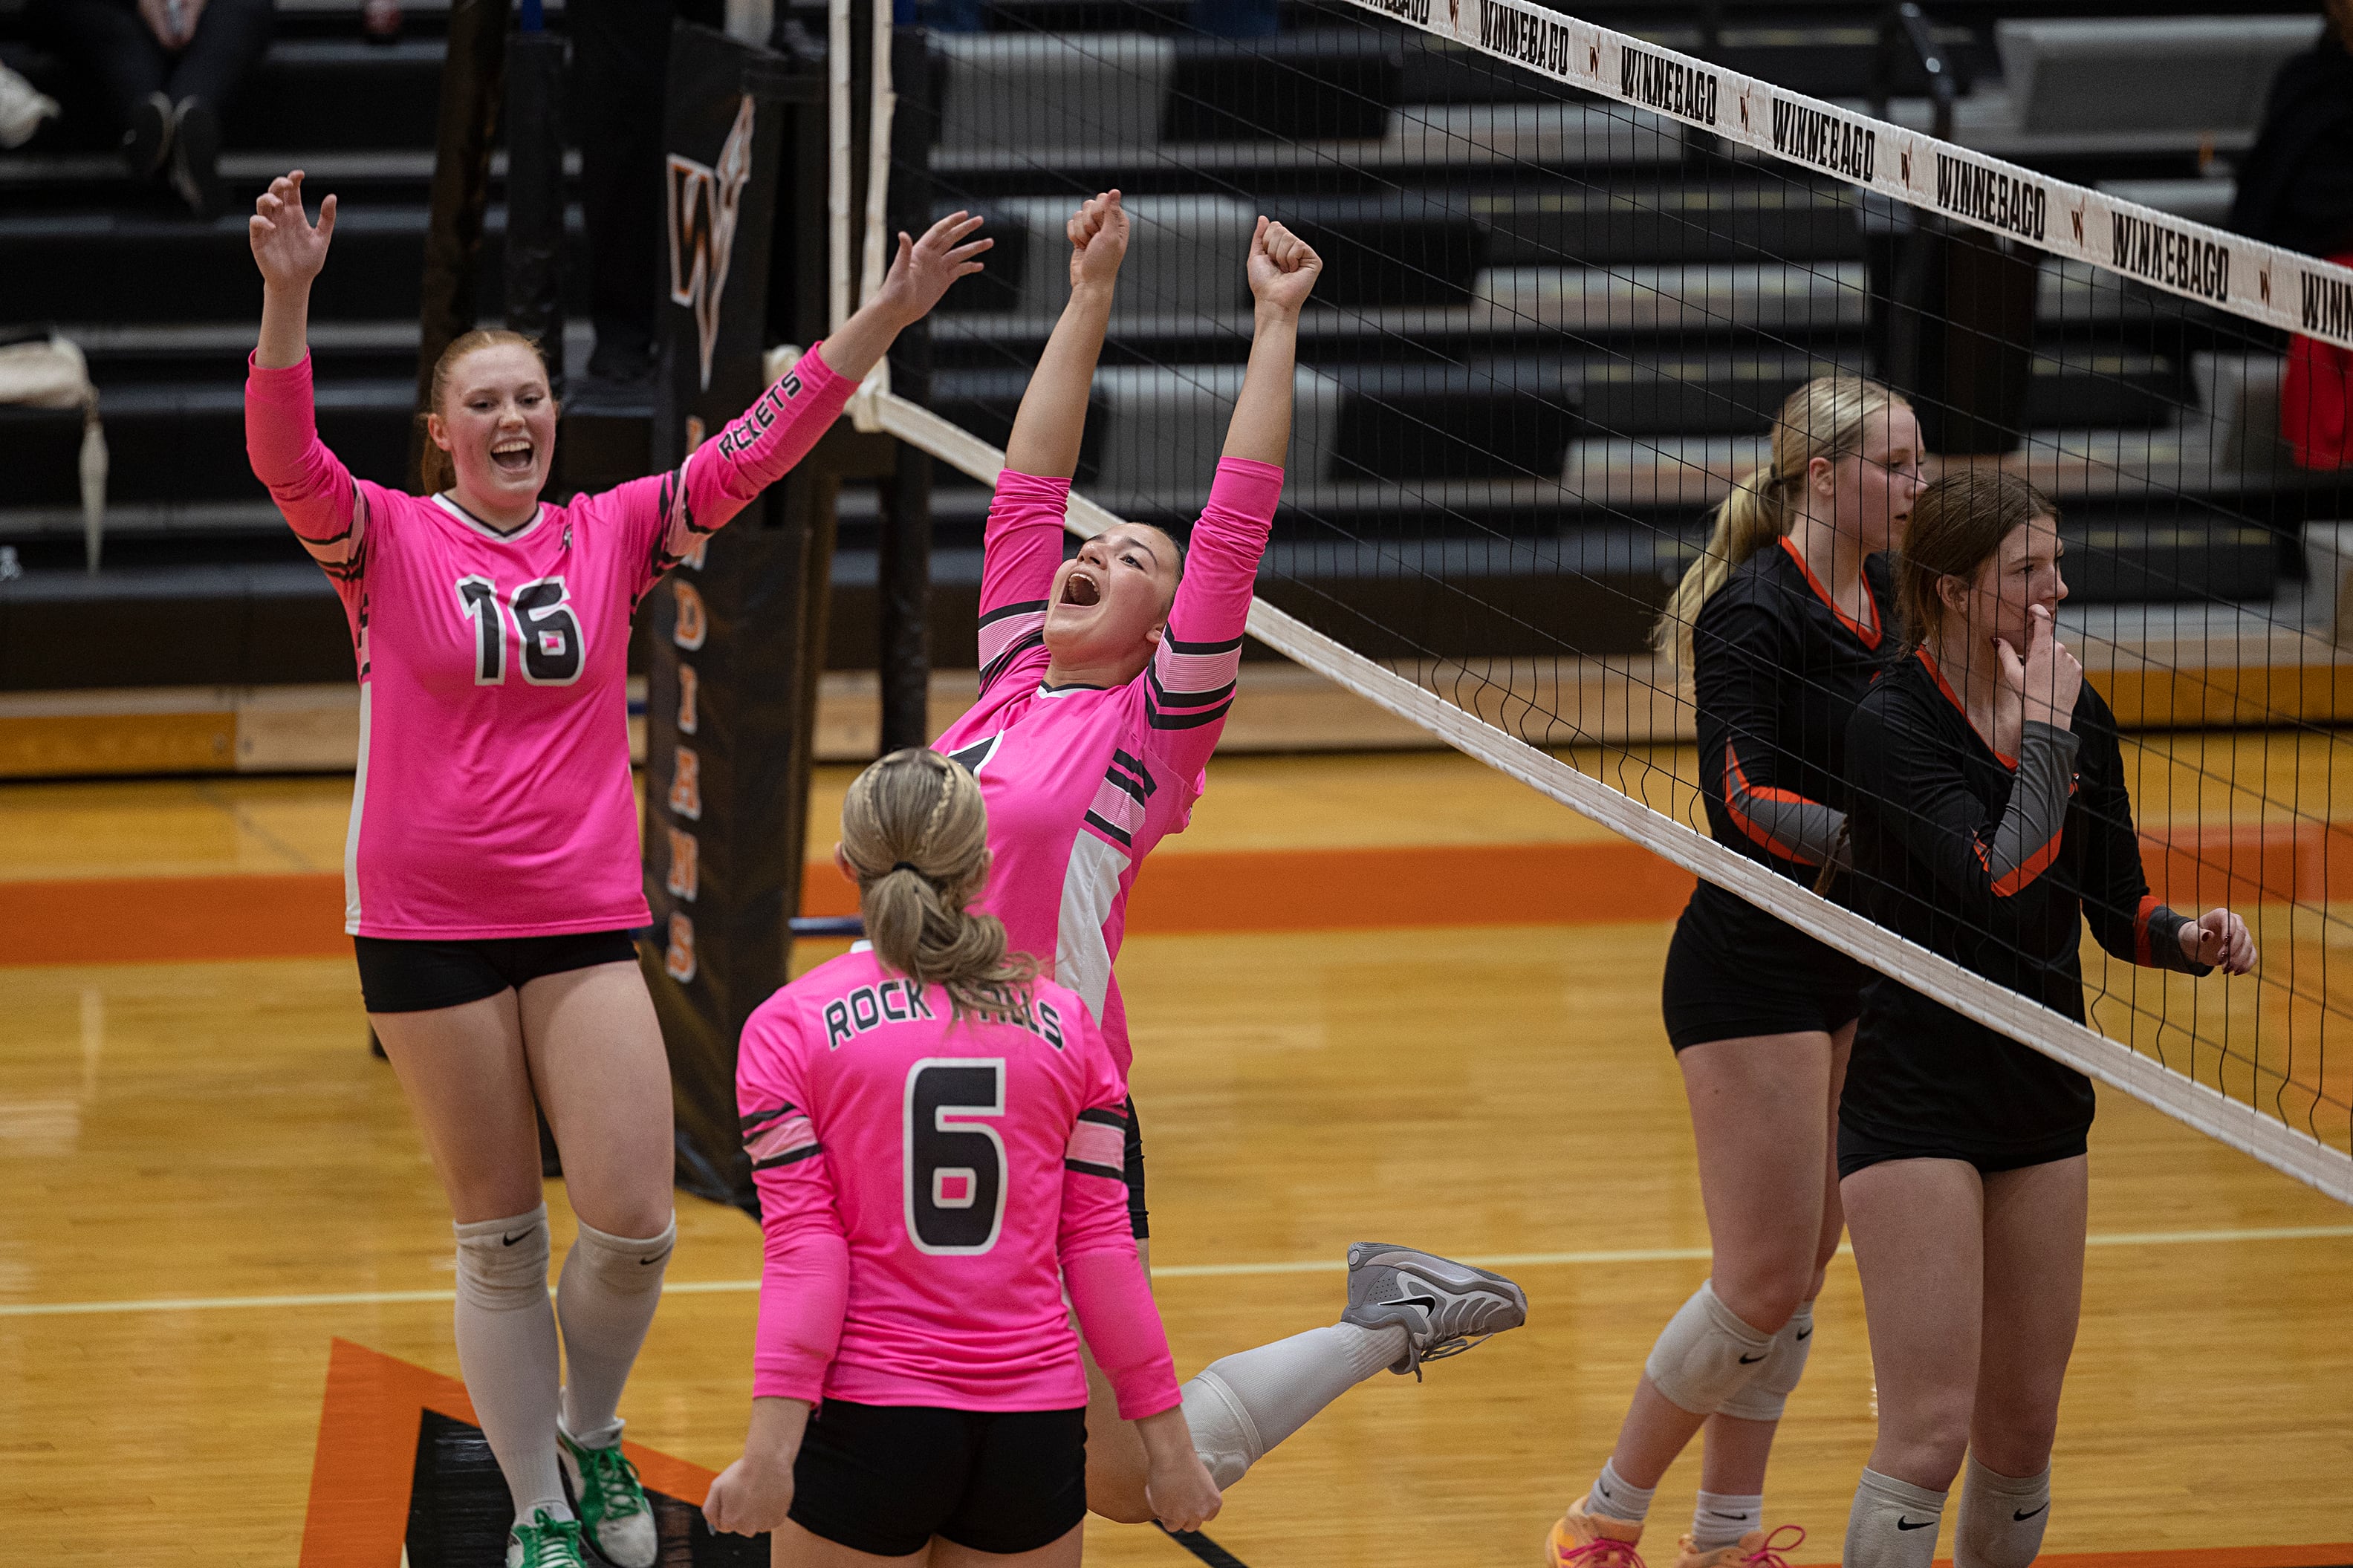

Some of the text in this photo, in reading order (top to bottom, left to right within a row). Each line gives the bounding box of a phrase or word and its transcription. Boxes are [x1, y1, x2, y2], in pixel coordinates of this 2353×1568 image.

[1479, 0, 1569, 76] WINNEBAGO
[1620, 45, 1717, 126] WINNEBAGO
[1773, 97, 1875, 183] WINNEBAGO
[1936, 152, 2046, 242] WINNEBAGO
[2111, 210, 2230, 304] WINNEBAGO
[718, 370, 803, 463] RCKETS
[454, 573, 585, 686] 16
[822, 975, 936, 1053] ROCK
[903, 1057, 1008, 1256] 6
